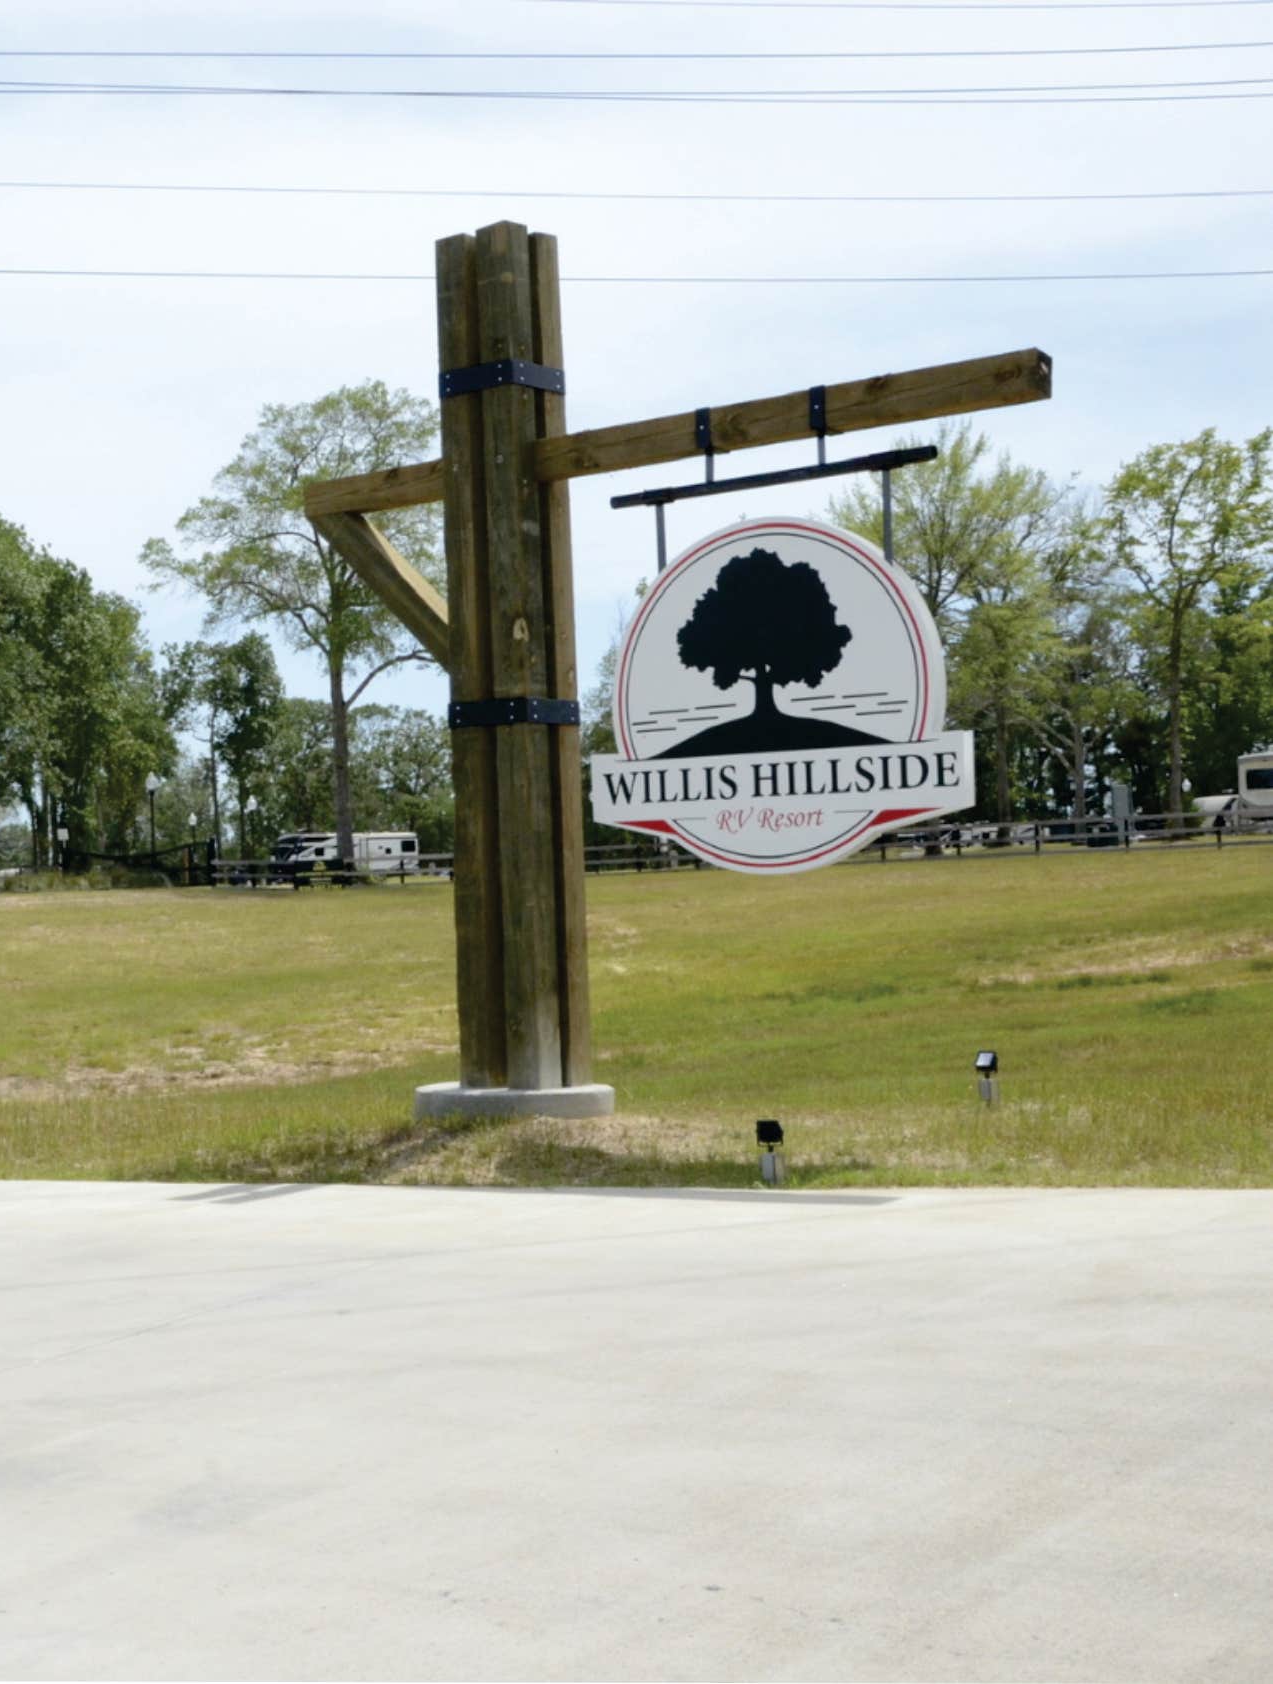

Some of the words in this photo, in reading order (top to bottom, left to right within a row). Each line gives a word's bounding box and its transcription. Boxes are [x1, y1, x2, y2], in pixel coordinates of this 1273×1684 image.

[603, 764, 738, 806] WILLIS
[750, 751, 960, 798] HILLSIDE
[716, 806, 755, 834] RV
[757, 807, 824, 832] Resort
